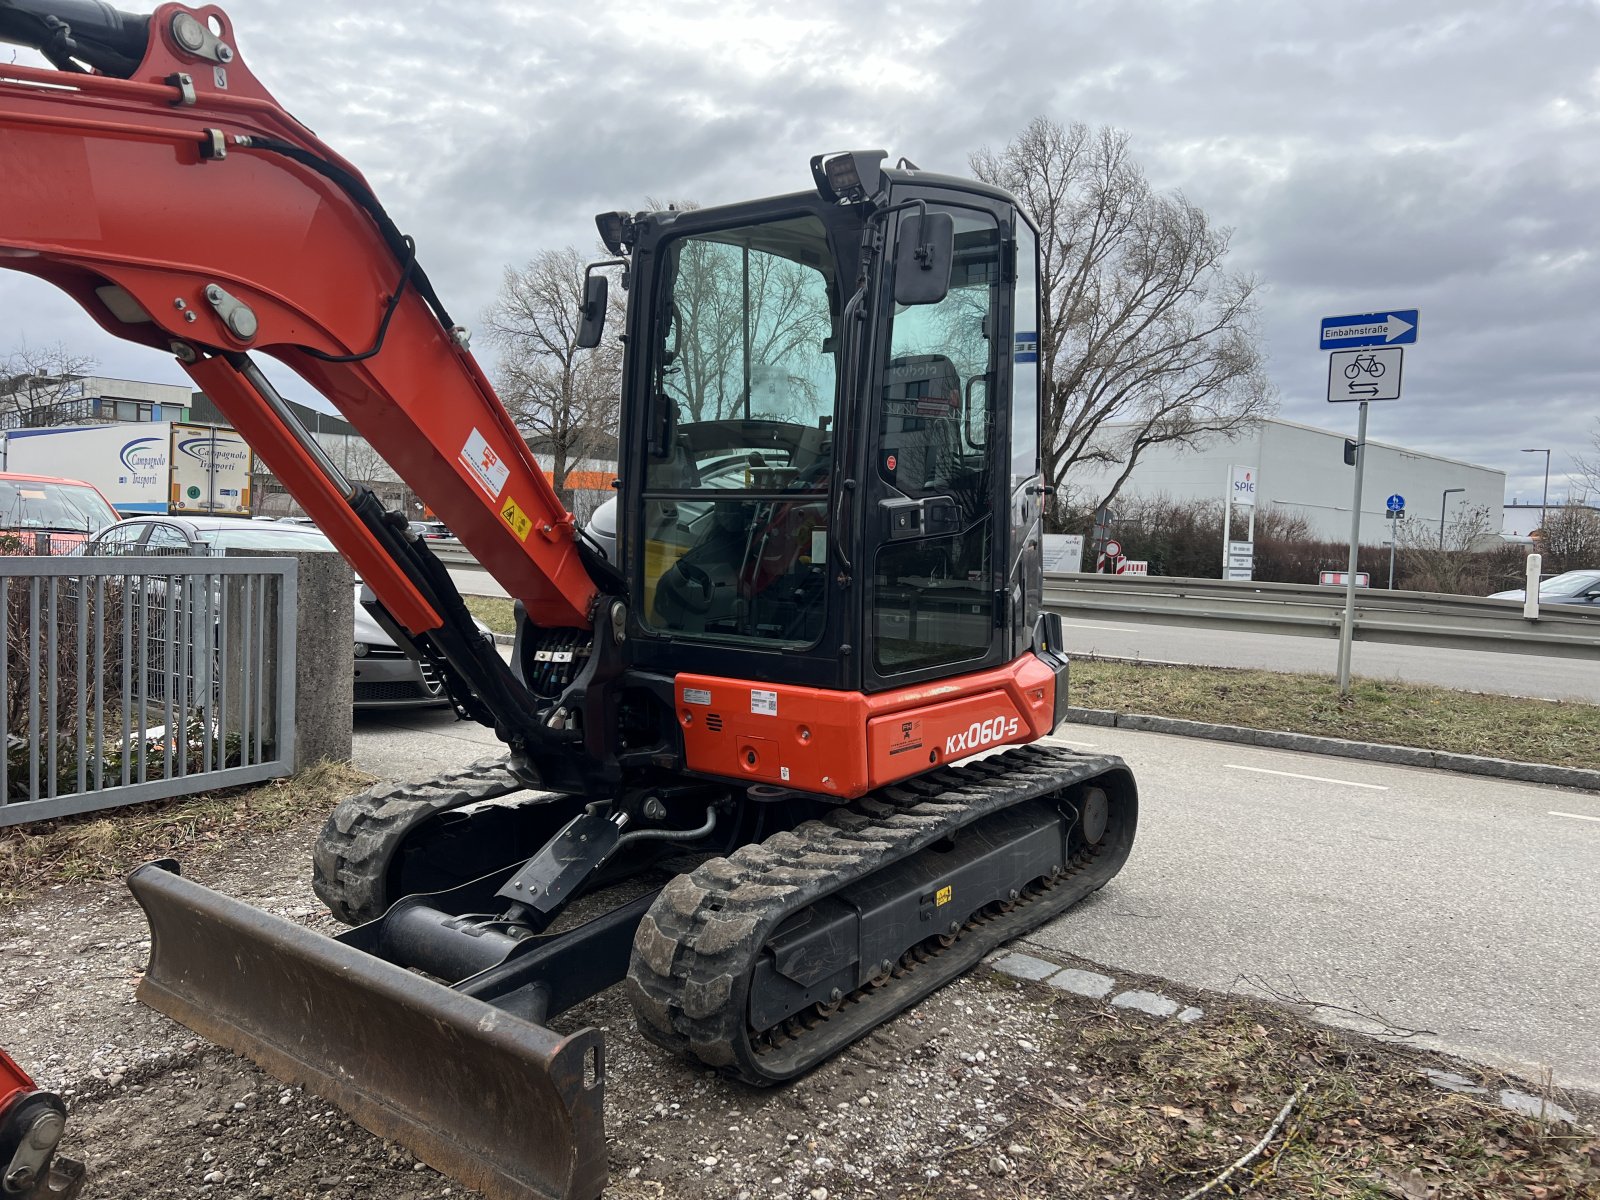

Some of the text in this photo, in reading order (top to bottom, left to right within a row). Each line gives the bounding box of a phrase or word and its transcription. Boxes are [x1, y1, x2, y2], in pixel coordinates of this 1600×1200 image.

[1325, 325, 1389, 338] Einbahnstraße
[892, 364, 937, 377] Kubota
[131, 453, 166, 470] Campagnolo
[1234, 481, 1255, 493] SPIE
[945, 715, 1019, 755] KX060-5
